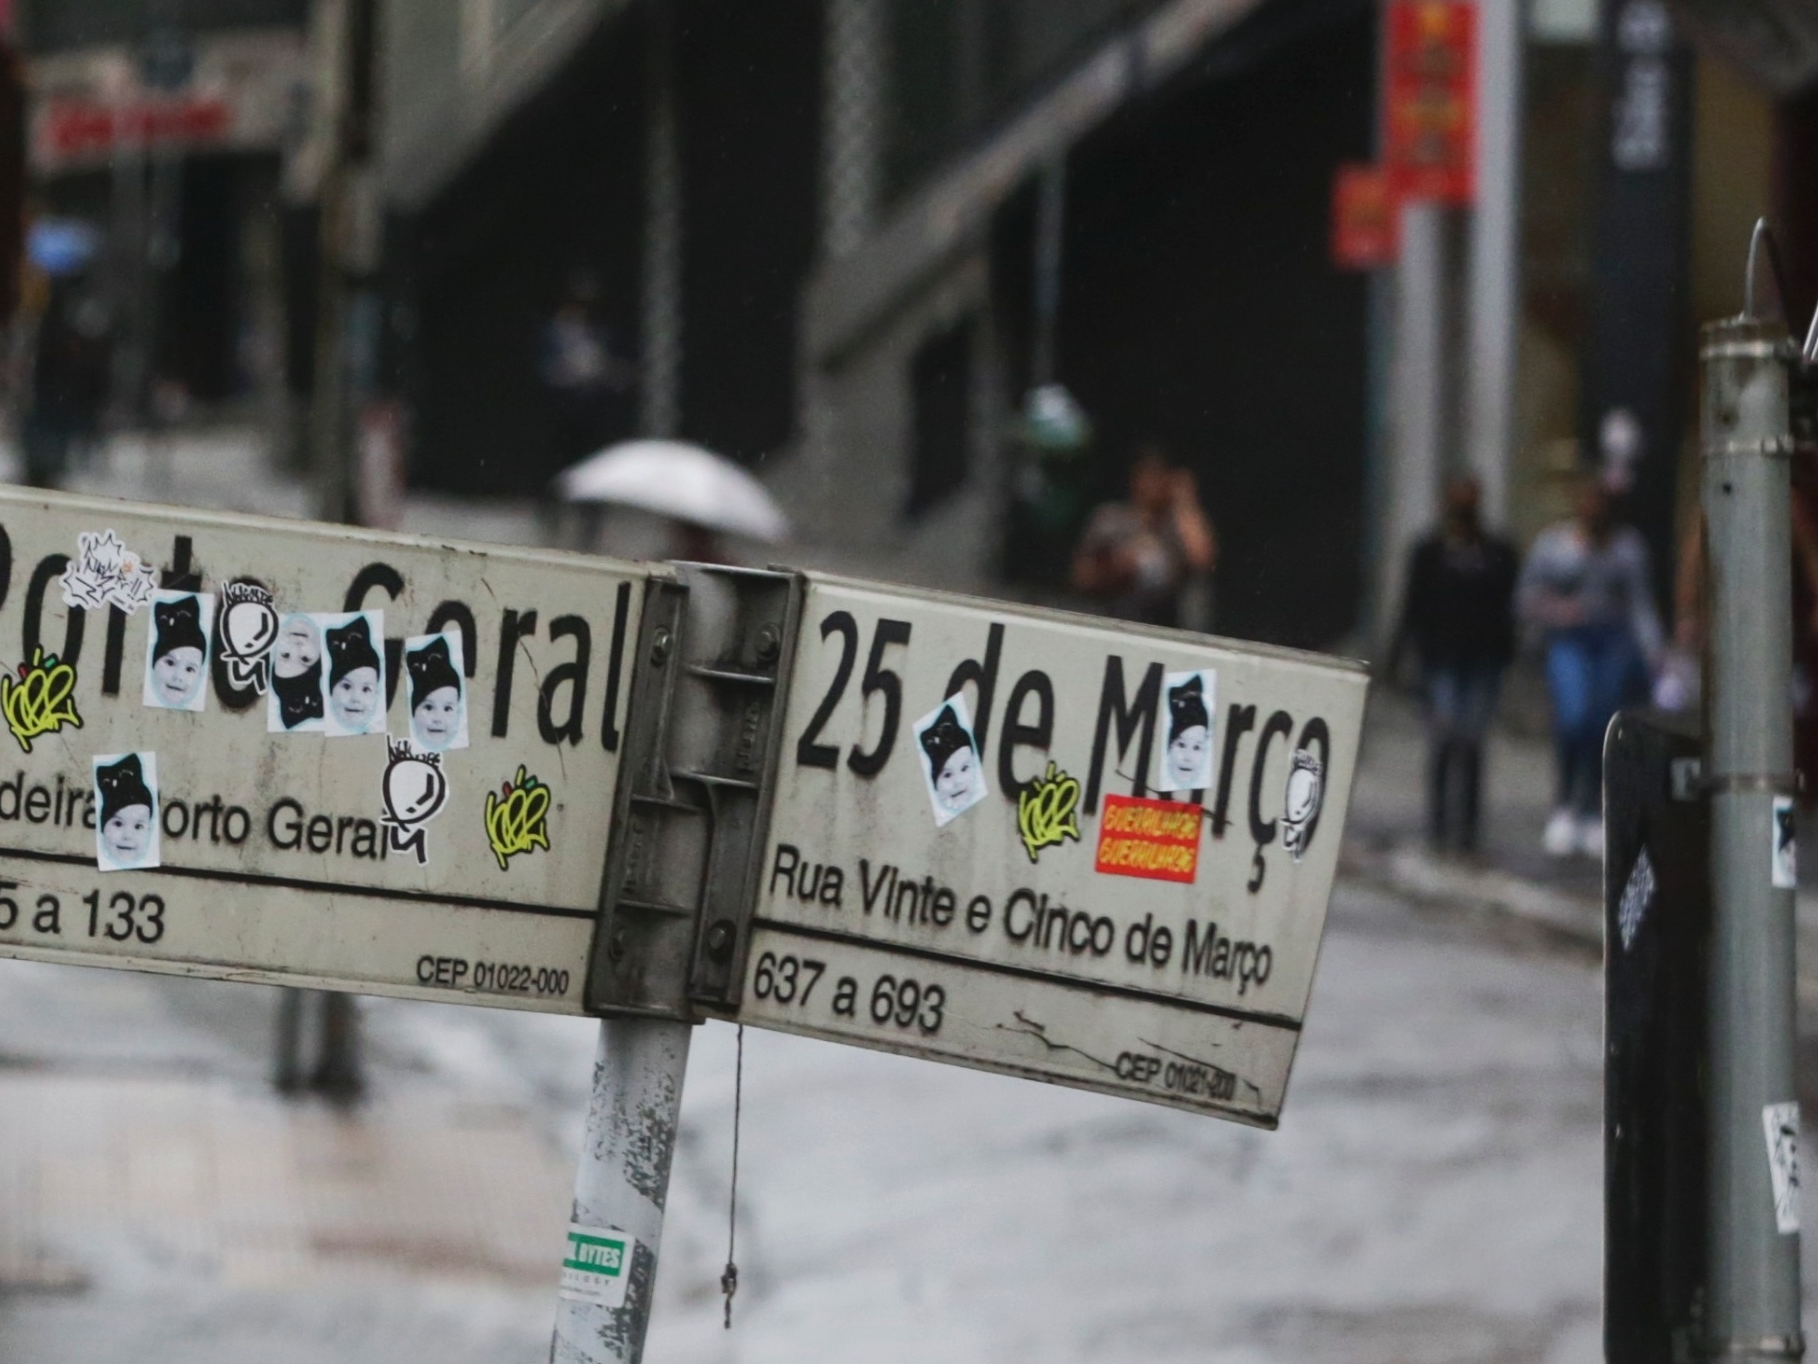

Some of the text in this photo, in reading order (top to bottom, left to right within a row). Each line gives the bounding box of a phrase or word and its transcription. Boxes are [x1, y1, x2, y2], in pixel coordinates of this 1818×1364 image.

[796, 610, 912, 780] 25
[1083, 654, 1330, 895] Mrço
[158, 791, 251, 845] orto
[32, 893, 62, 936] a
[82, 889, 166, 944] 133
[769, 842, 1272, 996] Rua Vinte e Cinco de Março
[416, 954, 570, 995] CEP 01022-000
[753, 951, 947, 1034] 637 a 693
[1114, 1050, 1162, 1084] CEP
